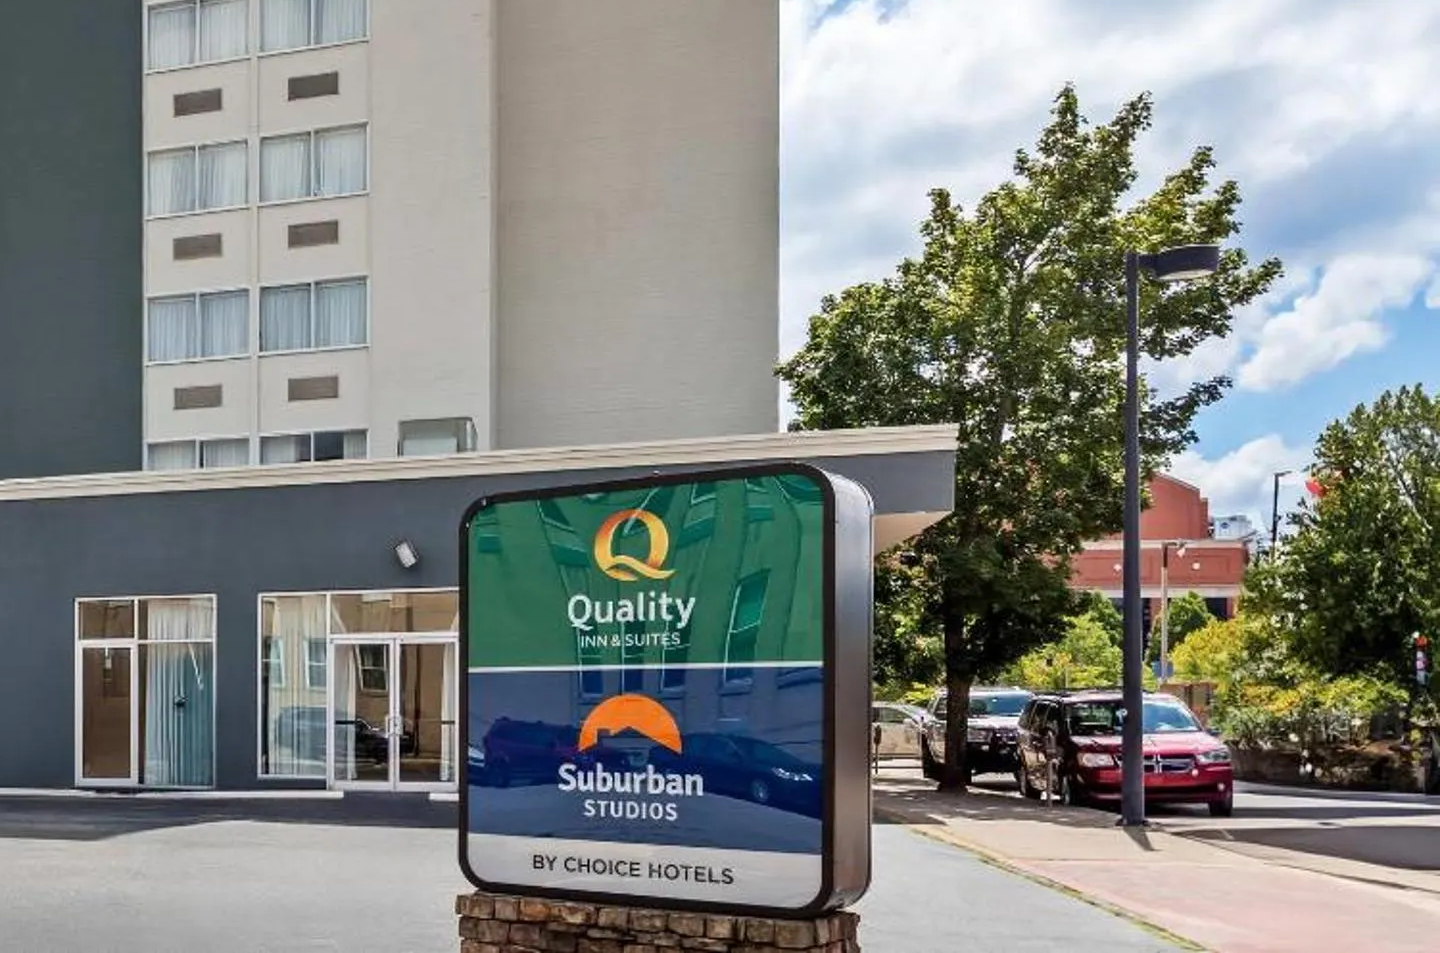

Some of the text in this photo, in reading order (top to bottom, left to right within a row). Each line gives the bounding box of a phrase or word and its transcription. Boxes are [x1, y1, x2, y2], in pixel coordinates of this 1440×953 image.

[594, 509, 677, 581] Q
[567, 591, 696, 631] Quality
[580, 633, 681, 647] INN & SUITES
[558, 763, 704, 797] Suburban
[584, 799, 678, 821] STUDIOS
[532, 854, 734, 885] BY CHOICE HOTELS
